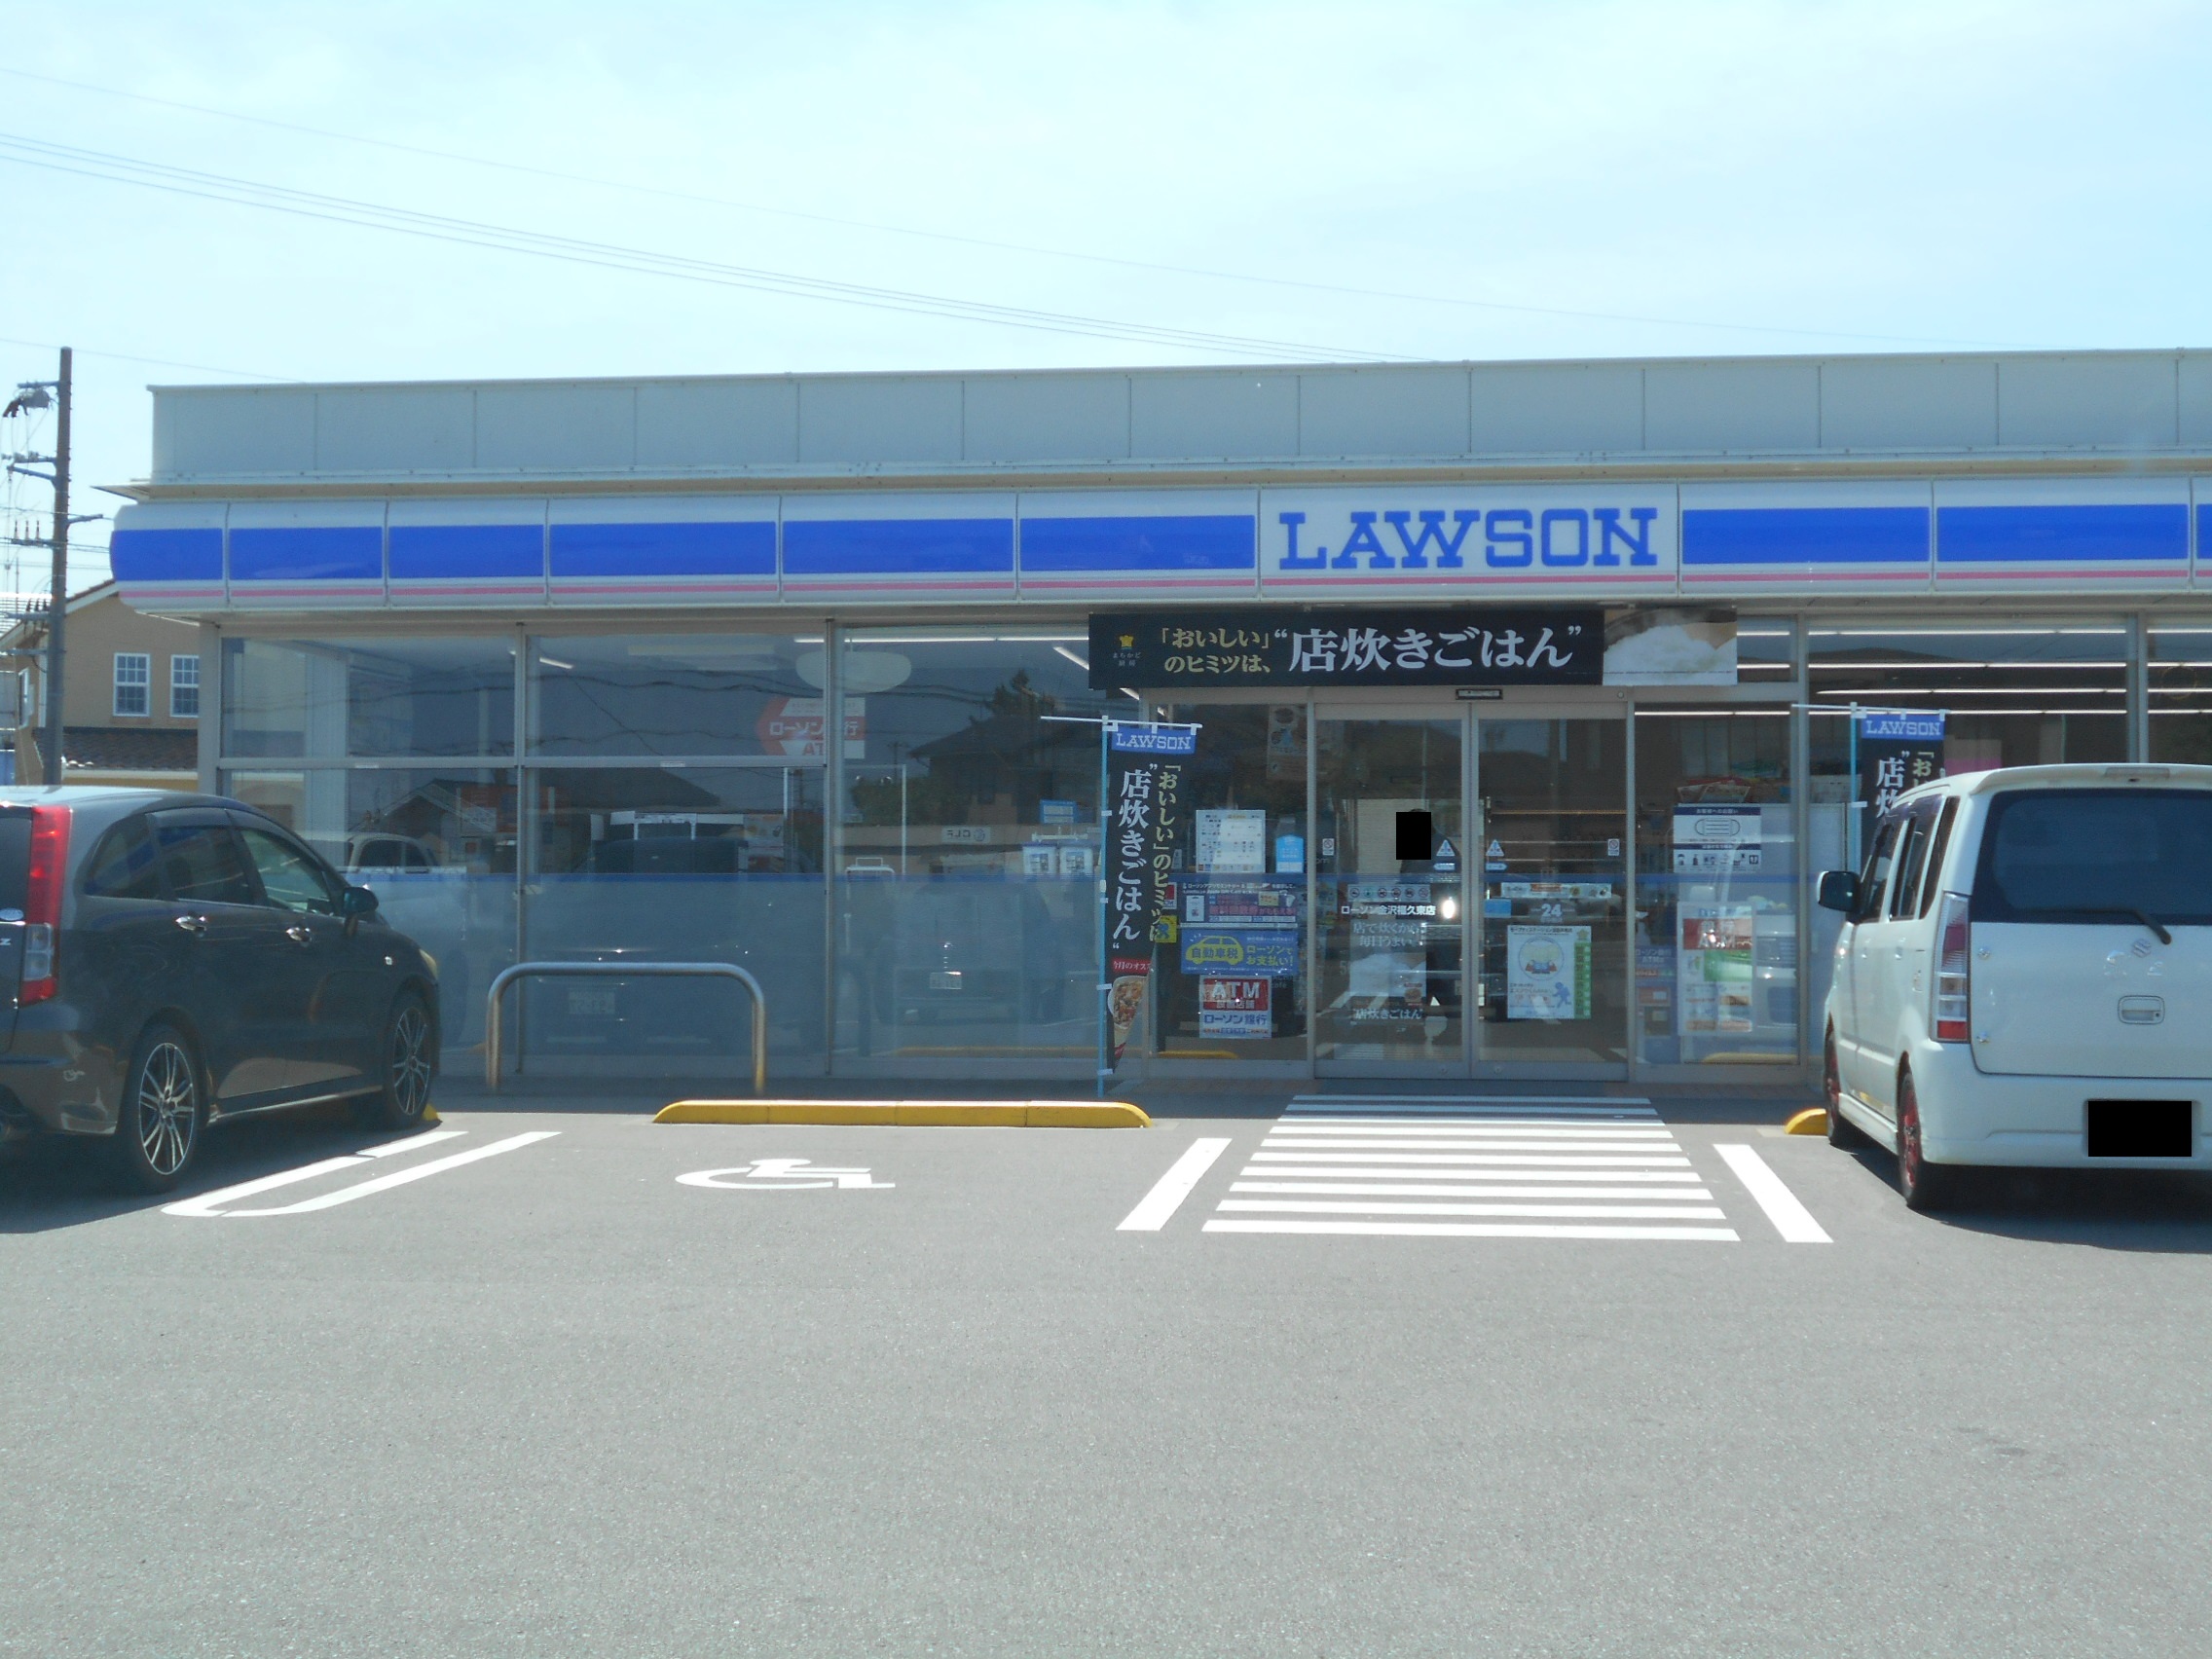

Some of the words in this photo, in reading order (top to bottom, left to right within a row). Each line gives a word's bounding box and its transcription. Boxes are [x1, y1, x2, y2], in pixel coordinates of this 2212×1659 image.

[1279, 507, 1657, 571] LAWSON
[1161, 627, 1270, 649] 「おいしい」
[1274, 626, 1582, 673] “店炊きごはん”
[1164, 654, 1272, 674] のヒミツは、
[769, 720, 859, 736] ローソン行
[1865, 719, 1941, 736] LAWSON
[1116, 732, 1192, 750] LAWSON
[1541, 903, 1563, 916] 24
[1247, 945, 1294, 954] ローソンで
[1698, 935, 1736, 948] AM
[1192, 947, 1238, 959] 自動車税
[1212, 980, 1260, 999] ATM
[1204, 1014, 1268, 1025] ローソン銀行
